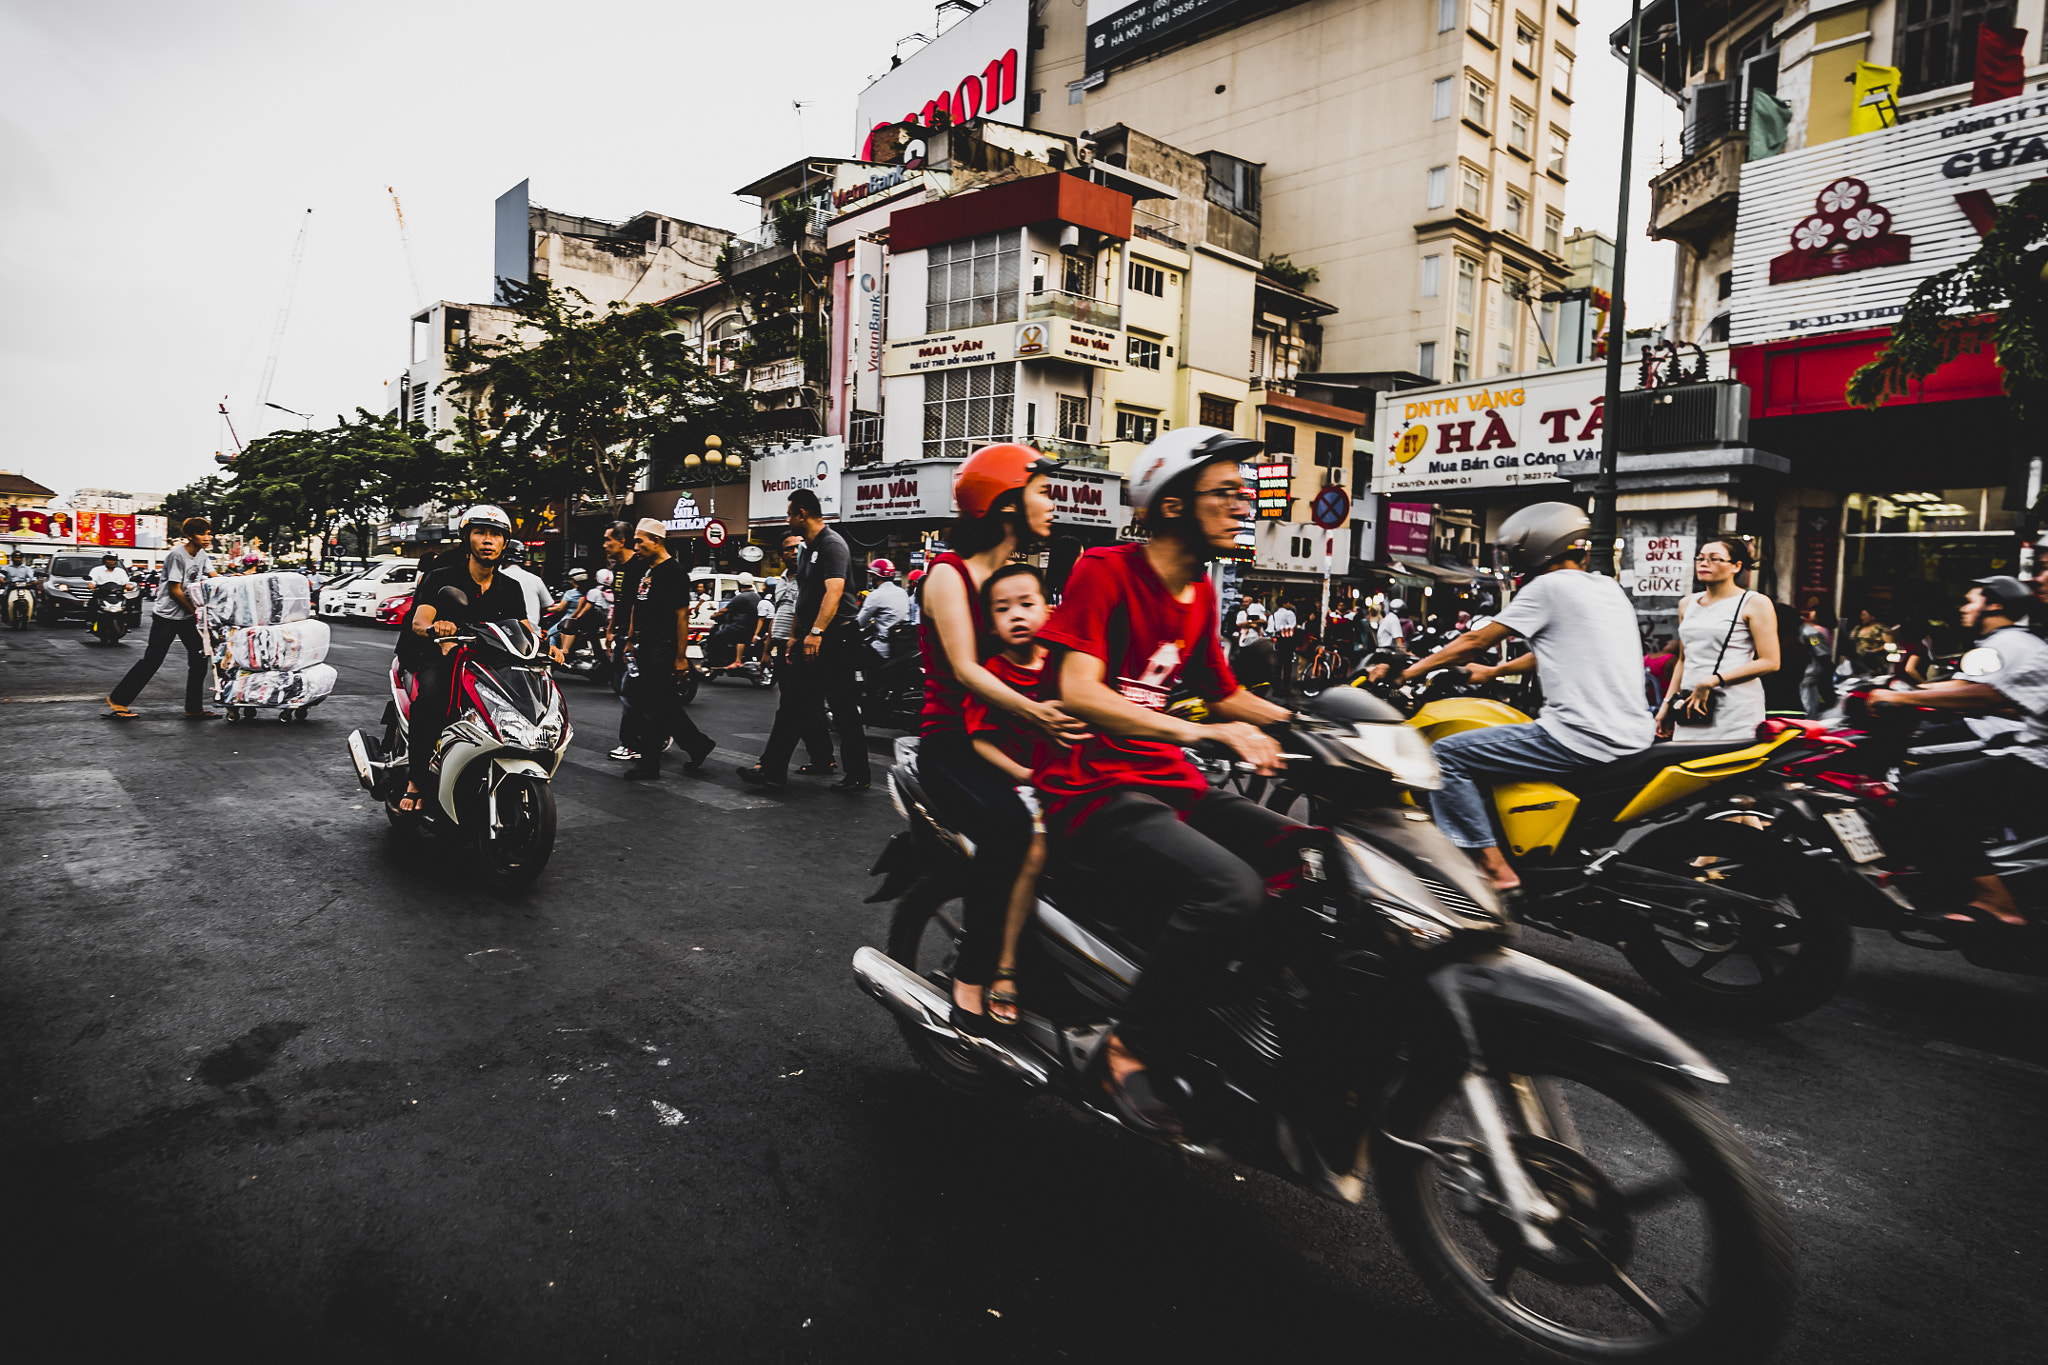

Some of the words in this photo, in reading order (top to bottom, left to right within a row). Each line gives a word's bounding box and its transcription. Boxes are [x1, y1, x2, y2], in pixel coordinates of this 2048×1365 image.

[1110, 33, 1124, 47] HÀ
[1126, 24, 1144, 38] NỘI
[2001, 107, 2030, 124] TY
[868, 294, 881, 373] VietinBank
[1070, 334, 1089, 347] MAI
[1091, 339, 1109, 351] VÂN
[918, 345, 947, 357] MAI
[952, 340, 983, 353] VÂN
[1405, 397, 1459, 419] DNTN
[1466, 388, 1525, 411] VÀNG
[1436, 409, 1516, 454] HÀ
[1429, 461, 1457, 474] Mua
[1461, 457, 1489, 471] Bán
[1493, 455, 1519, 468] Gia
[1524, 452, 1566, 466] Công
[761, 474, 816, 493] VietinBank
[857, 484, 884, 501] MAI
[888, 478, 918, 498] VÂN
[1072, 484, 1102, 506] VÂN
[1667, 551, 1683, 561] XE
